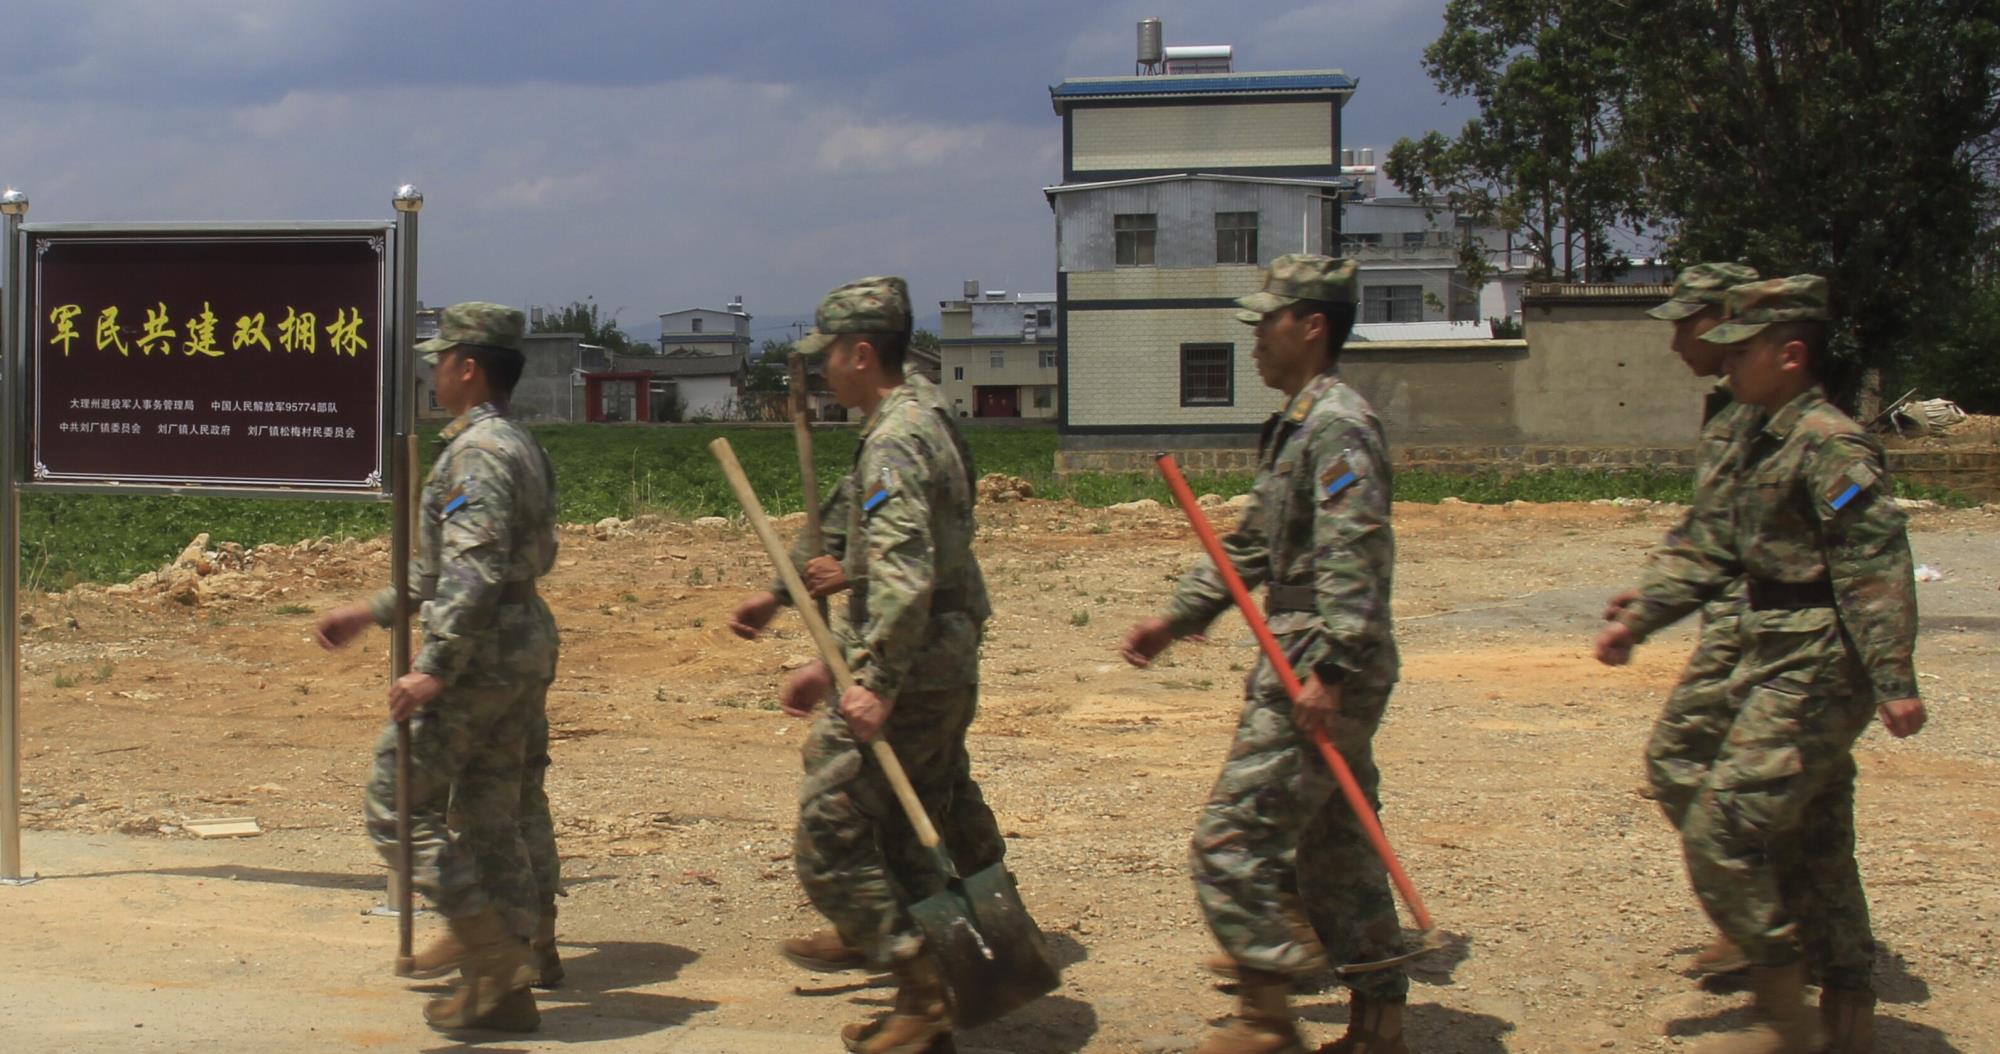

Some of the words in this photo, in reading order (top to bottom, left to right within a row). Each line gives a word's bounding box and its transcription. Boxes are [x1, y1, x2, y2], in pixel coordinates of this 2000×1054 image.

[49, 301, 369, 357] 军民共建双拥林
[69, 398, 195, 411] 大理州退役军人事务管理局
[210, 400, 338, 413] 中国人民解放军95774部队
[59, 422, 142, 435] 中共刘厂镇委员会
[157, 423, 231, 436] 刘厂镇人民政府
[247, 425, 356, 439] 刘厂镇松梅村民委员会
